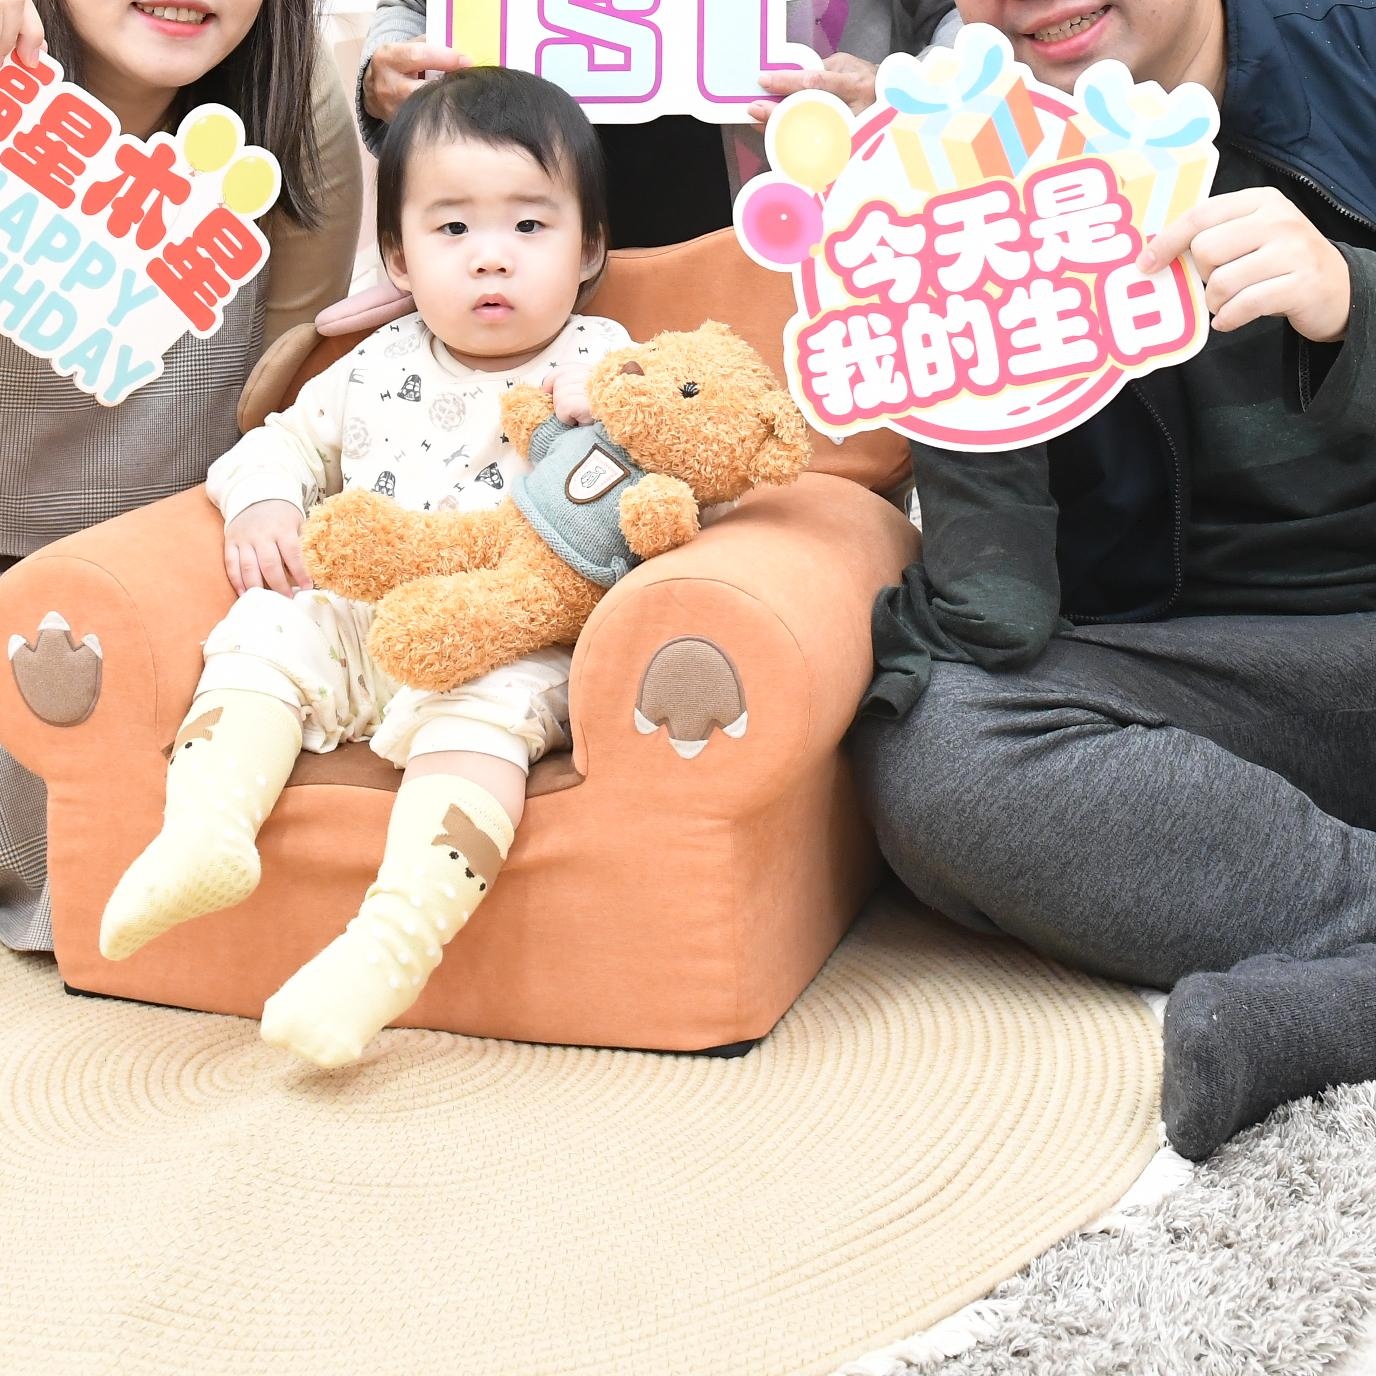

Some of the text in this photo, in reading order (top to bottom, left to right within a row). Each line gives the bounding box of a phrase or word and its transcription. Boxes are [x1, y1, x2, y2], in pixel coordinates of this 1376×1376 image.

[832, 166, 1133, 304] 今天是
[805, 261, 1187, 417] 我的生日
